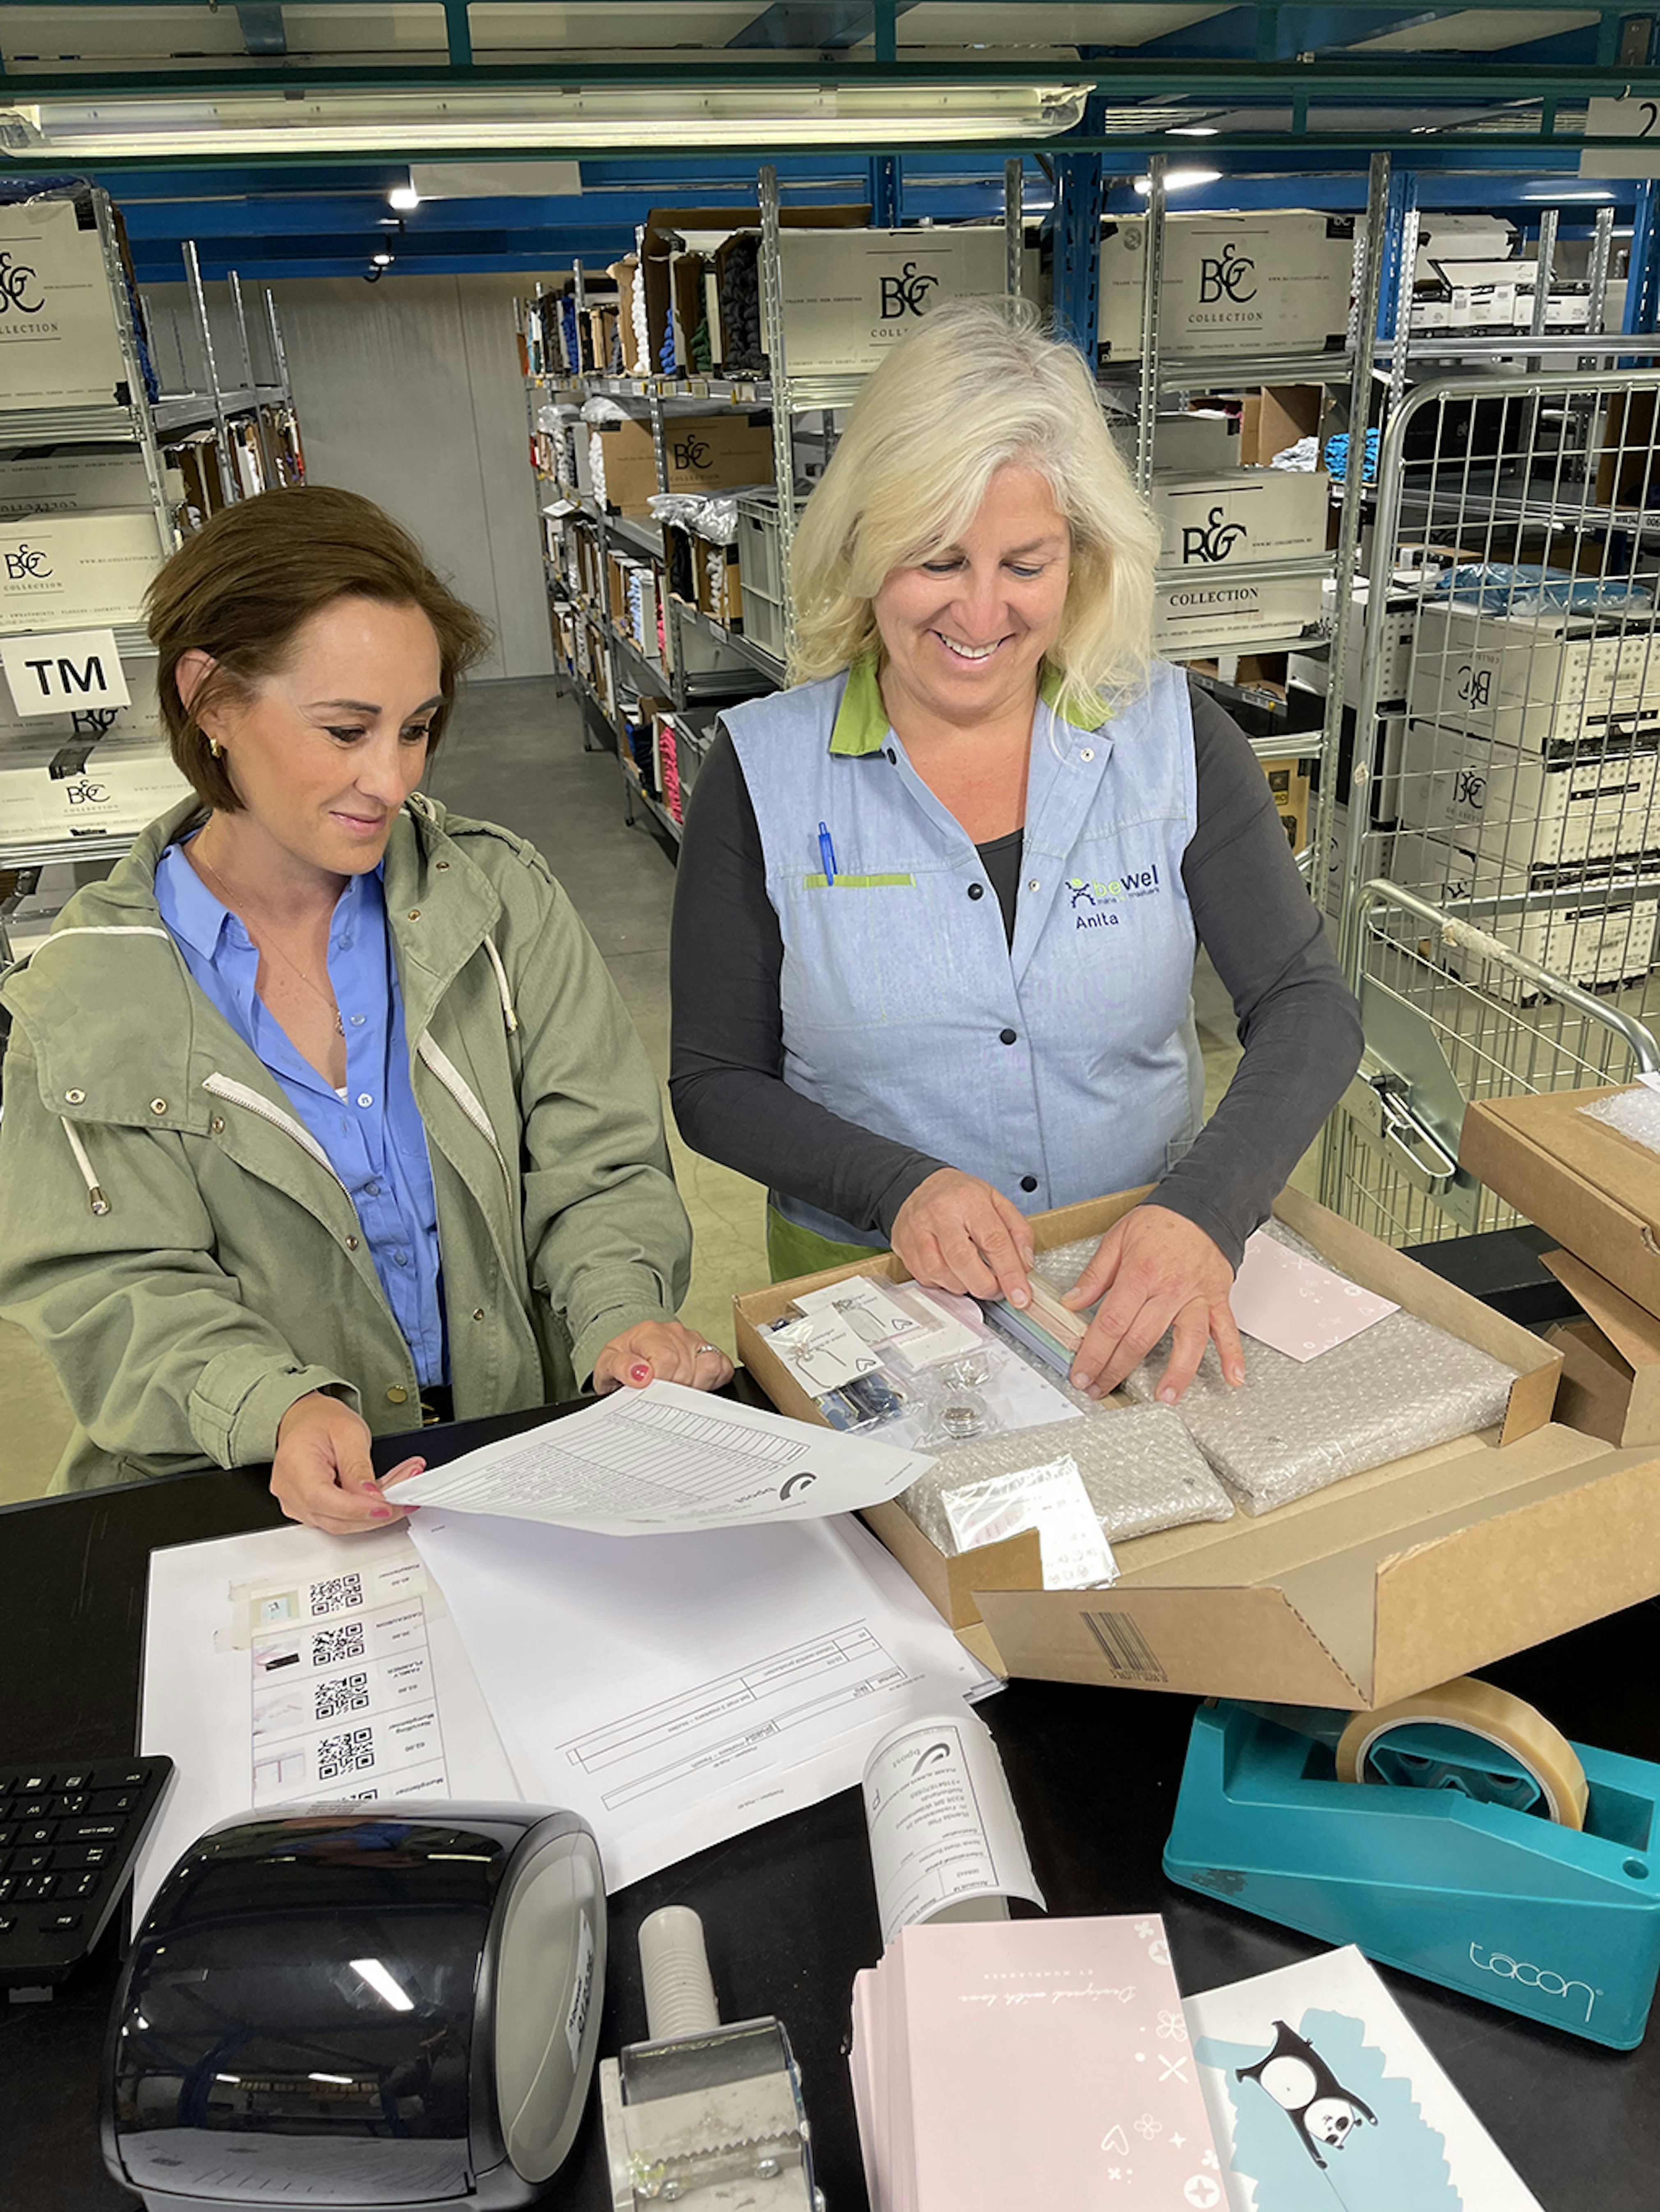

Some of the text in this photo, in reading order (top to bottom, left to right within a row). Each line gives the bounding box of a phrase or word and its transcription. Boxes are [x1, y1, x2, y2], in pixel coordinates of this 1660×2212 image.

[0, 252, 45, 313] &C
[1199, 243, 1257, 303] B&C
[1188, 312, 1263, 323] COLLECTION
[674, 434, 713, 470] B&C
[4, 544, 54, 579] B&C
[3, 582, 63, 592] COLLECTION
[1170, 588, 1259, 606] COLLECTION
[25, 656, 107, 695] TM
[66, 780, 111, 804] B&C
[1091, 864, 1160, 897] bewel
[957, 1982, 1137, 2007] Designed with love
[1469, 1942, 1595, 2023] tacon
